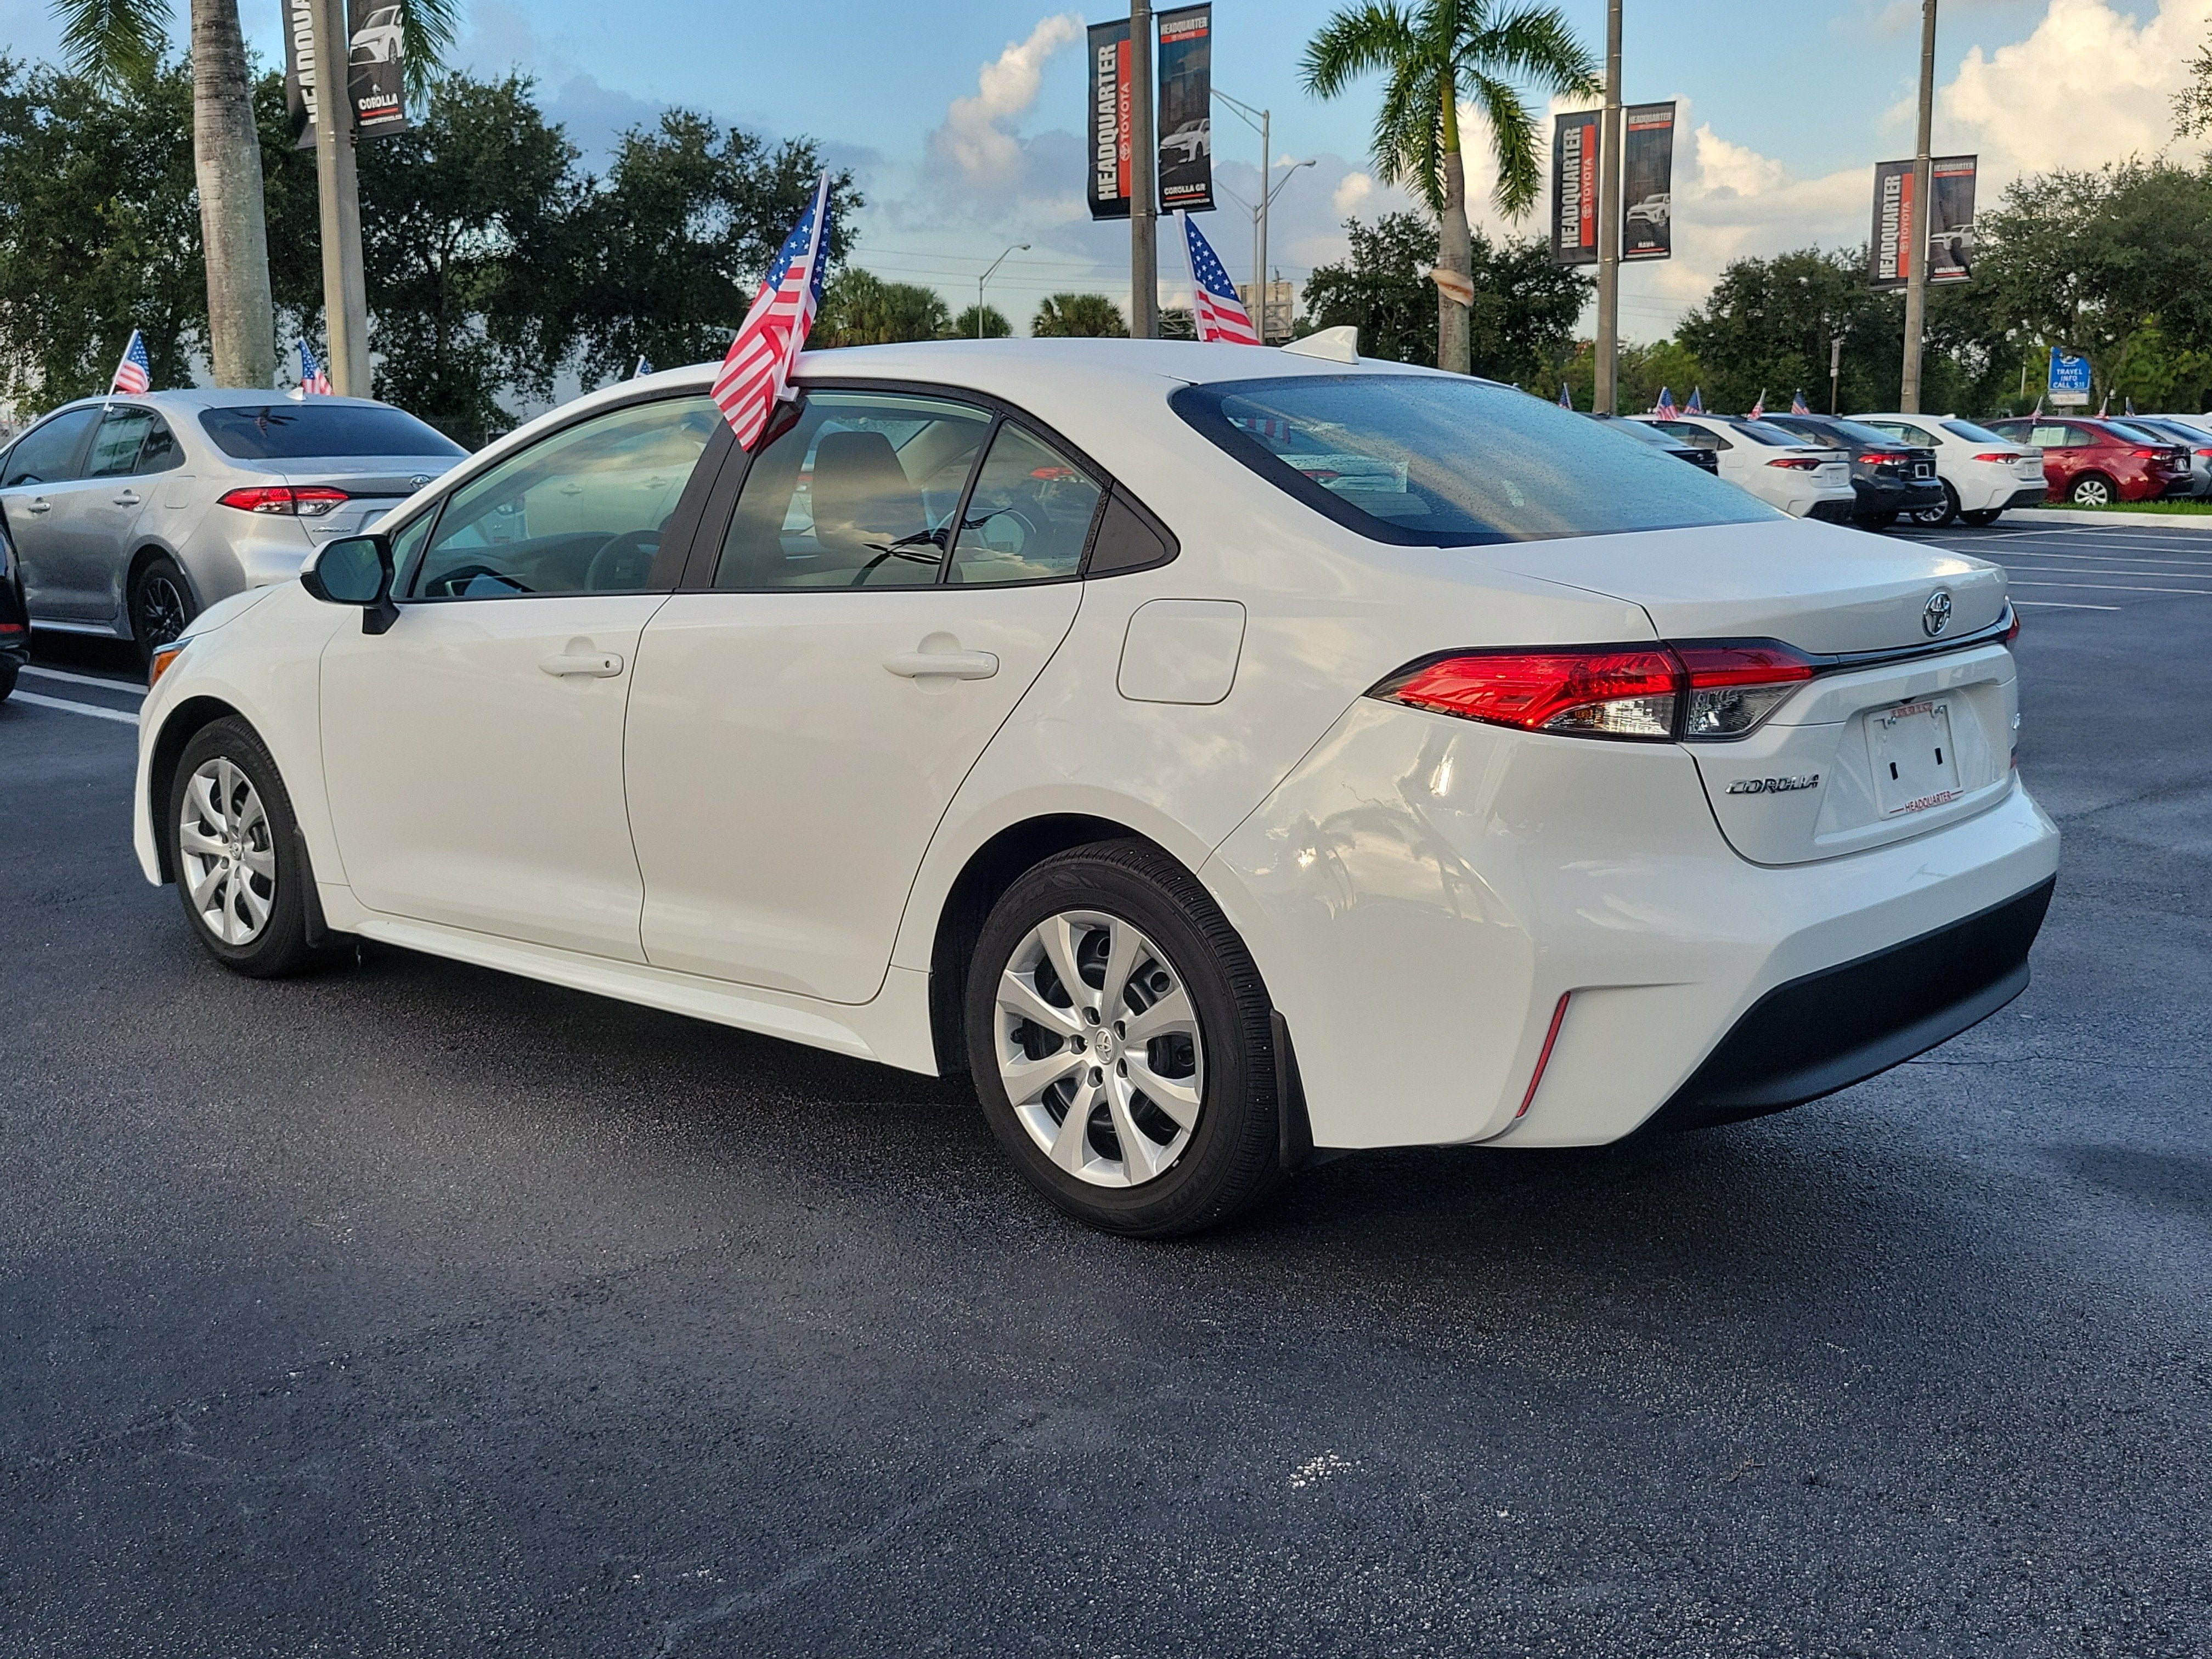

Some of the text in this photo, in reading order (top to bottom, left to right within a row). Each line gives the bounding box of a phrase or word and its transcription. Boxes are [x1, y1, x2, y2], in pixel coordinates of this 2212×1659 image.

[358, 93, 398, 110] COROLLA
[1098, 44, 1119, 200] HEADQUARTER
[1120, 82, 1130, 142] TOYOTA
[1164, 185, 1194, 196] COROLLA
[1561, 127, 1582, 247] HEADQUARTER
[1583, 157, 1593, 204] TOYOTA
[1879, 175, 1901, 279] HEADQUARTER
[1901, 201, 1911, 240] TOYOTA
[1725, 774, 1819, 794] COROLLA
[1904, 791, 1951, 812] HEADQUARTER
